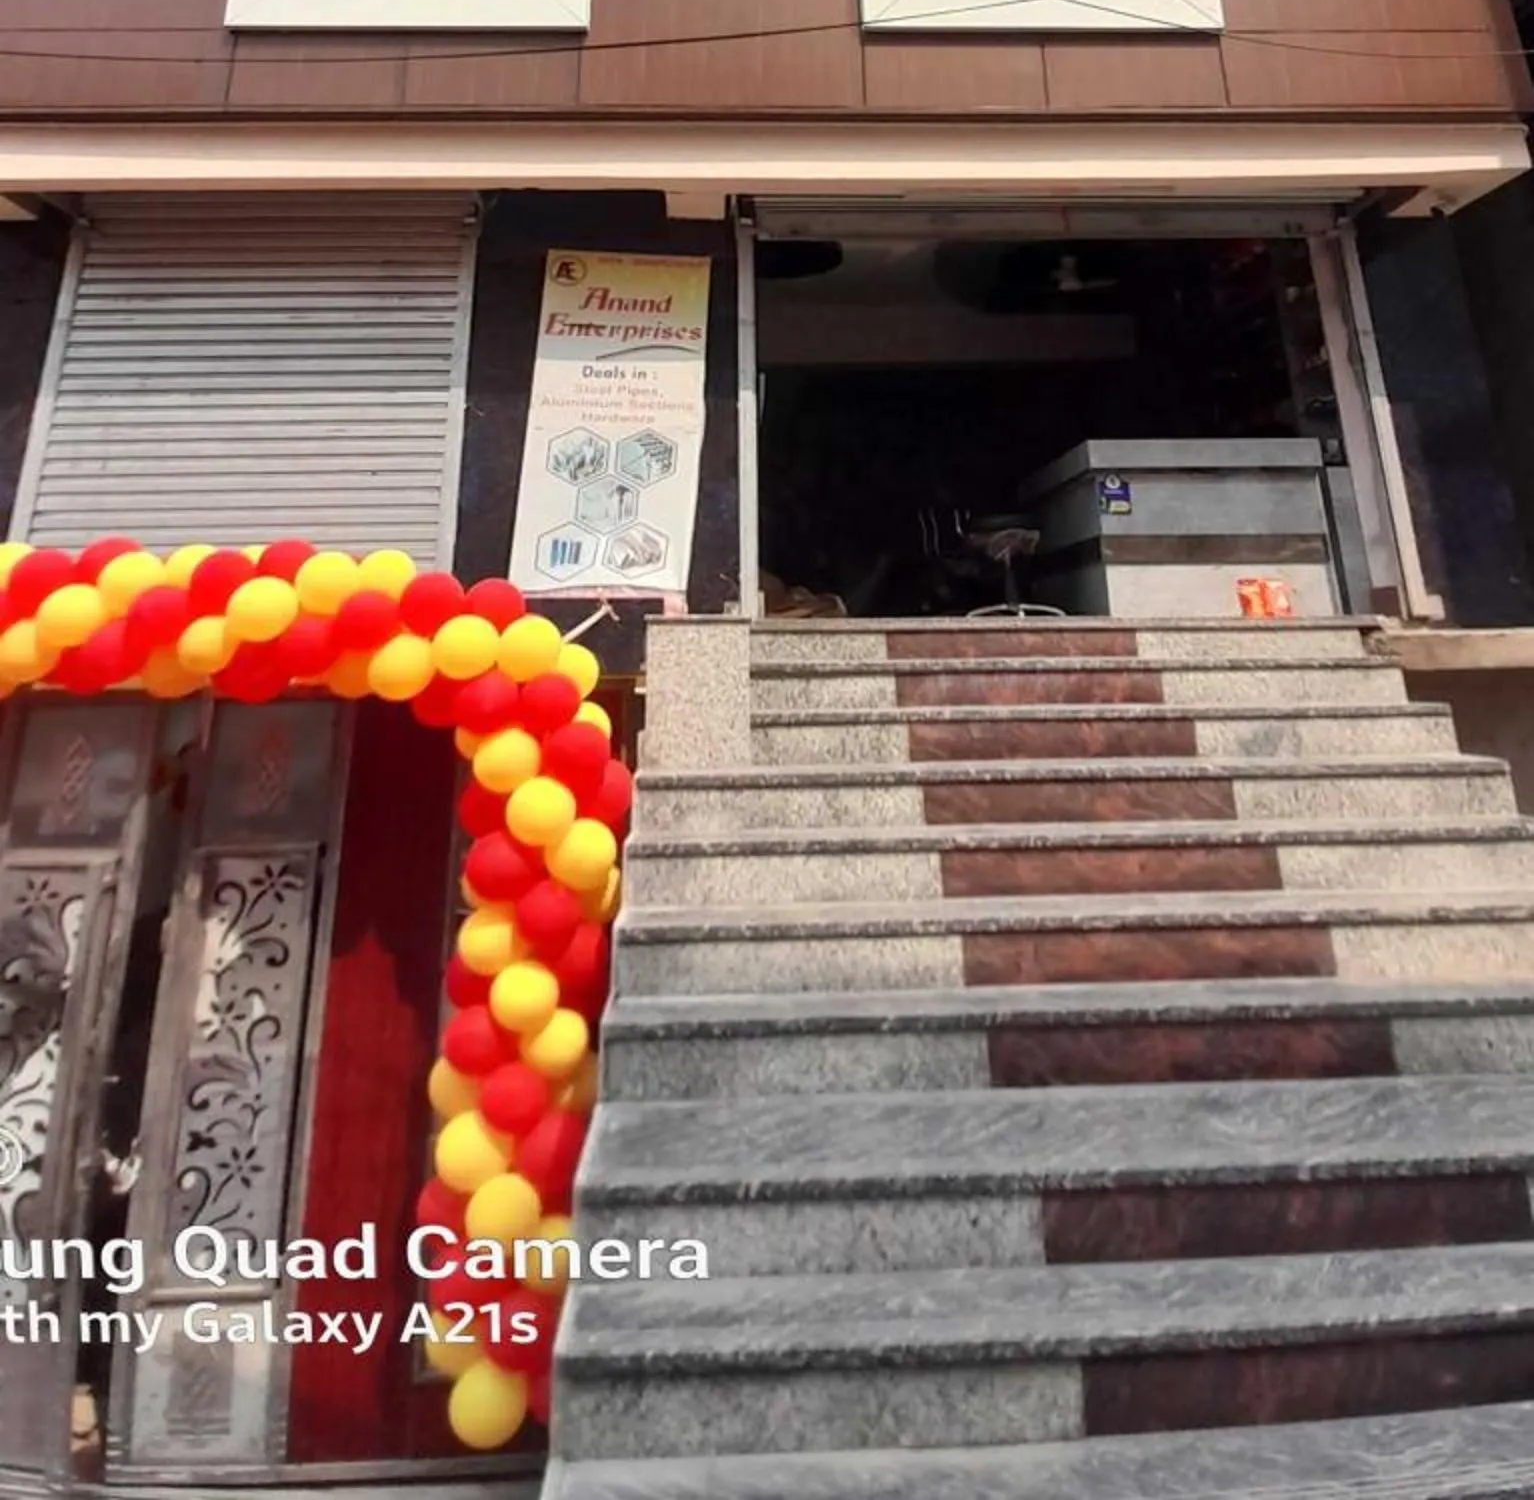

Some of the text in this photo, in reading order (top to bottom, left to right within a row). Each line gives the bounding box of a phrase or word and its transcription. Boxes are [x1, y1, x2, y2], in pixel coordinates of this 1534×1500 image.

[578, 286, 672, 313] Anand
[545, 312, 702, 342] Enterprises
[582, 365, 626, 379] Deals
[632, 366, 647, 380] in
